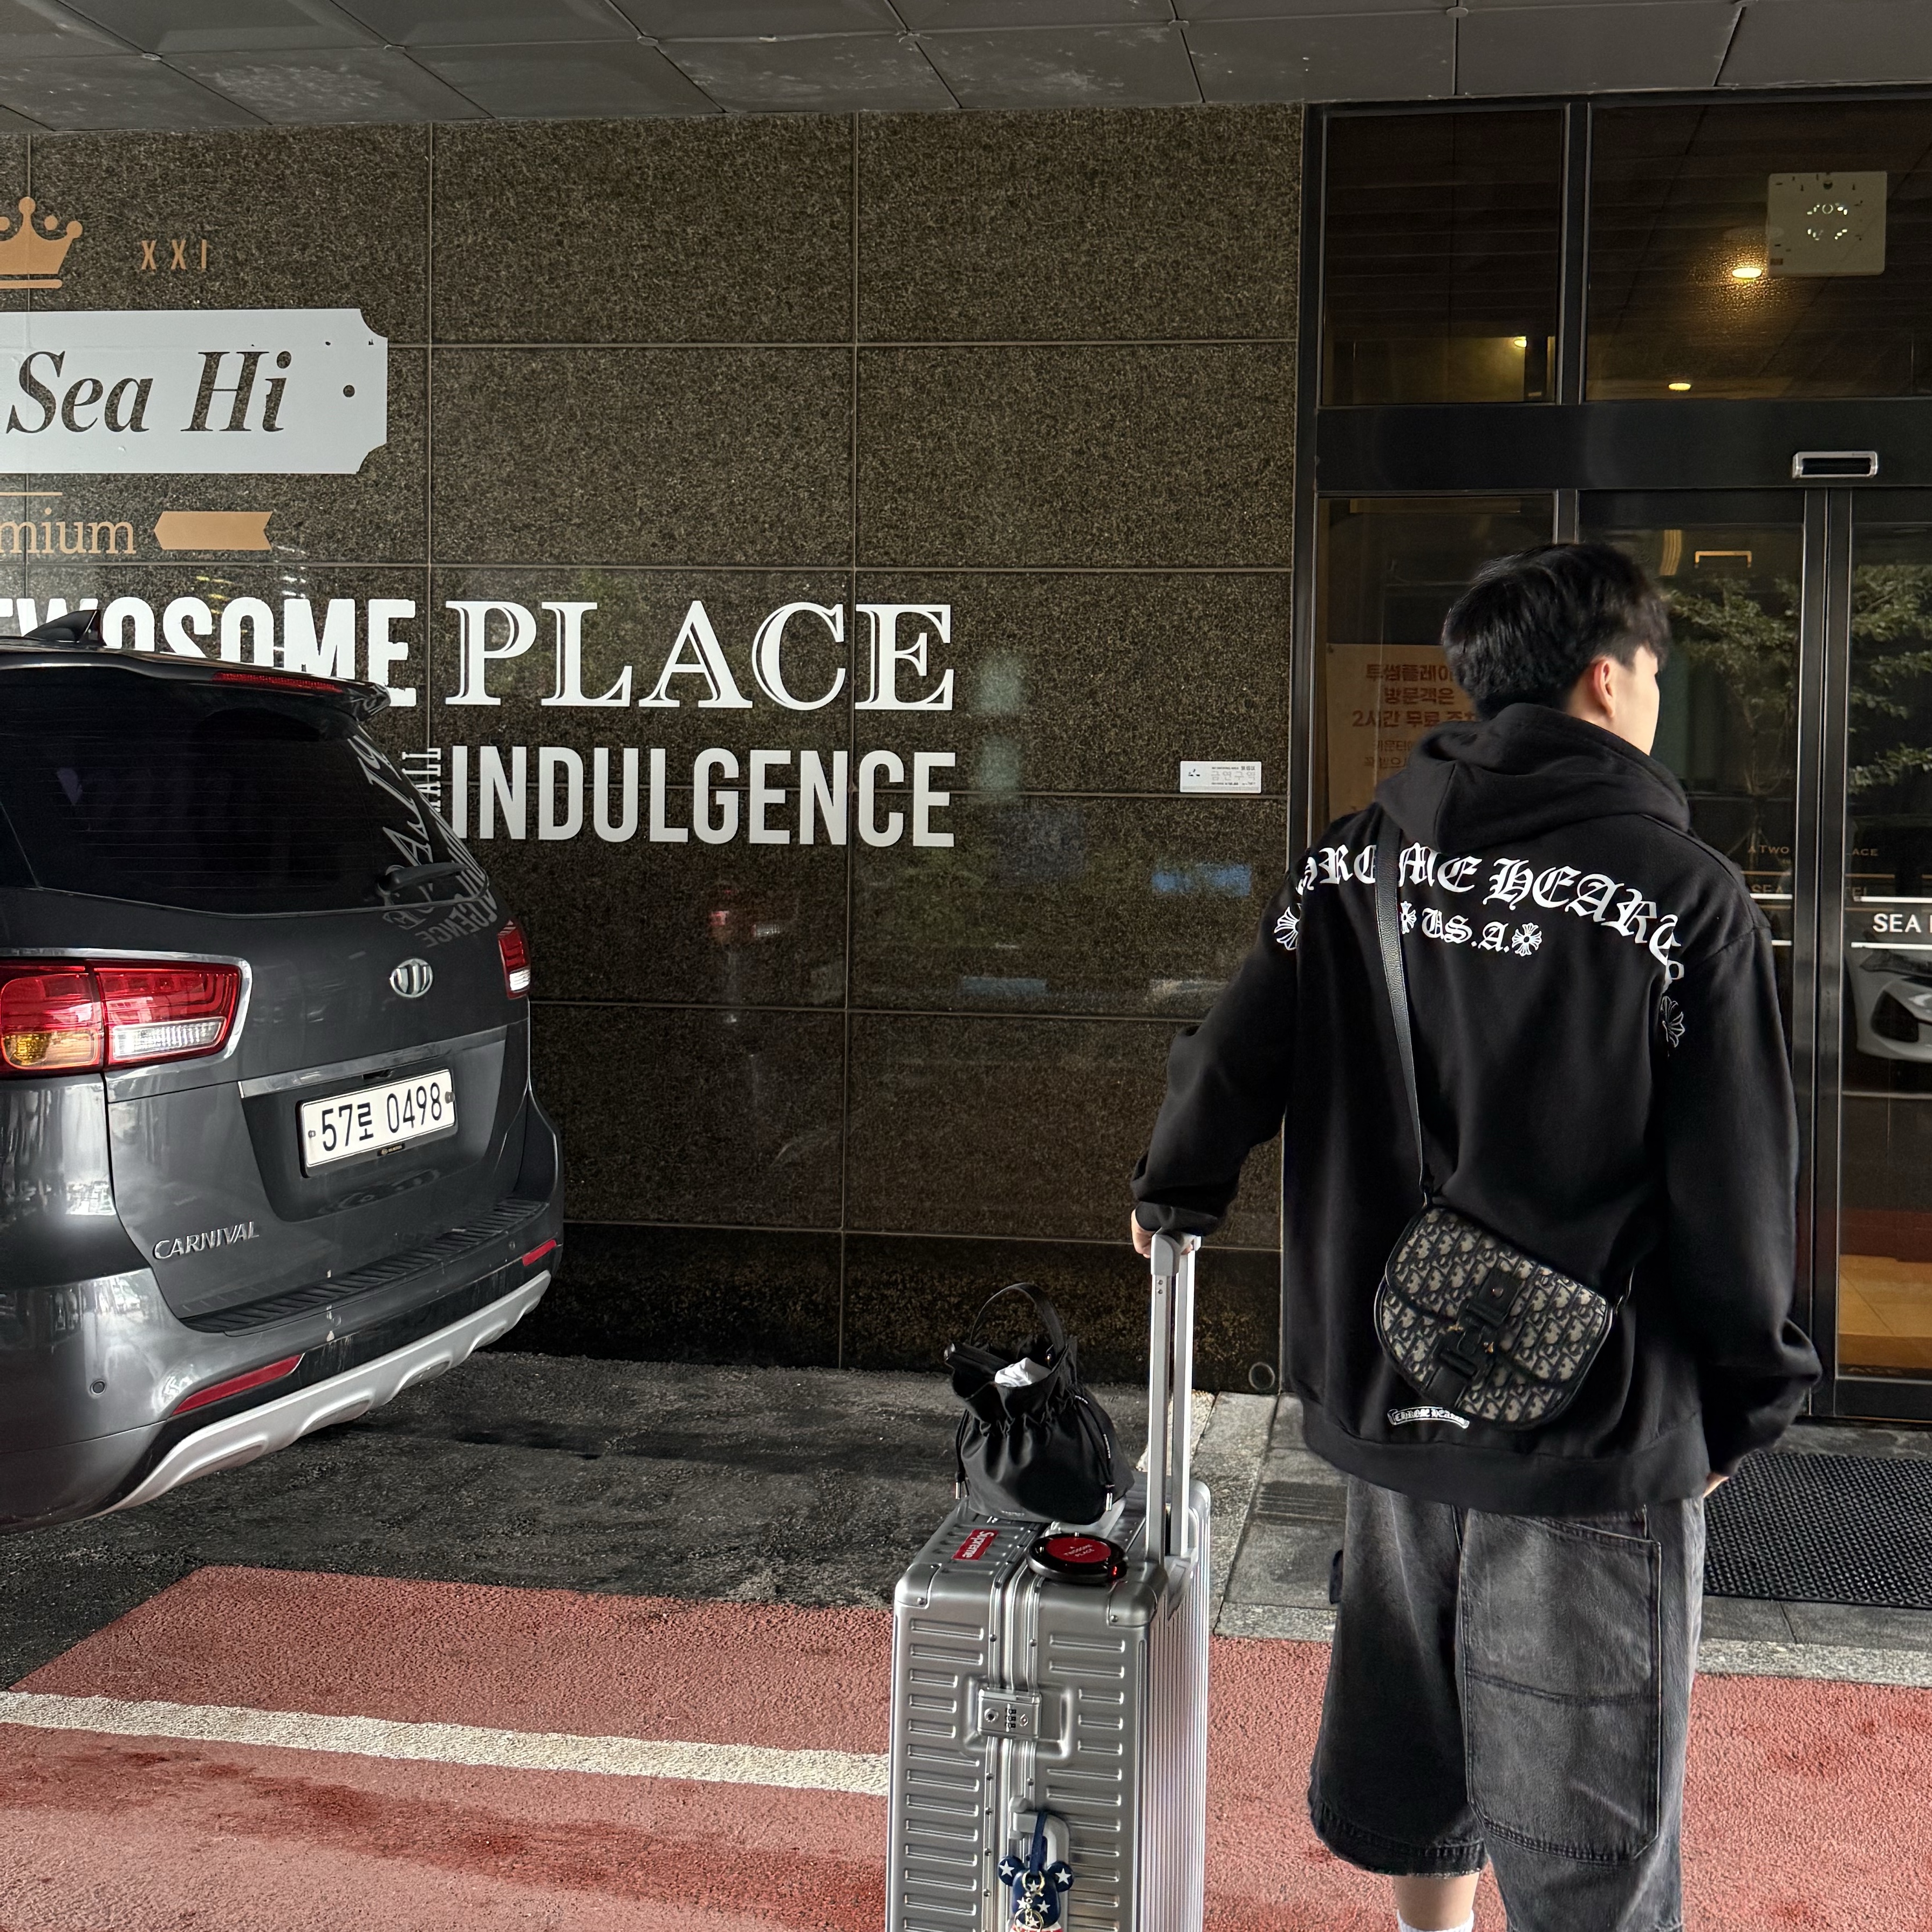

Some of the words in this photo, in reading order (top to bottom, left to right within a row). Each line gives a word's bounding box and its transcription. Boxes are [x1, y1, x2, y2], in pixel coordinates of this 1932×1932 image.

[6, 351, 153, 433] Sea
[181, 351, 292, 432] Hi
[446, 600, 954, 711] PLACE
[1384, 688, 1454, 705] 방문객은
[1352, 711, 1399, 728] 2시간
[1211, 771, 1255, 781] 금연구역
[452, 746, 956, 848] INDULGENCE
[1873, 913, 1921, 933] SEA
[322, 1102, 373, 1151] 57로
[387, 1082, 442, 1133] 0498
[154, 1221, 260, 1259] CARNIVAL
[962, 1531, 994, 1558] Supreme
